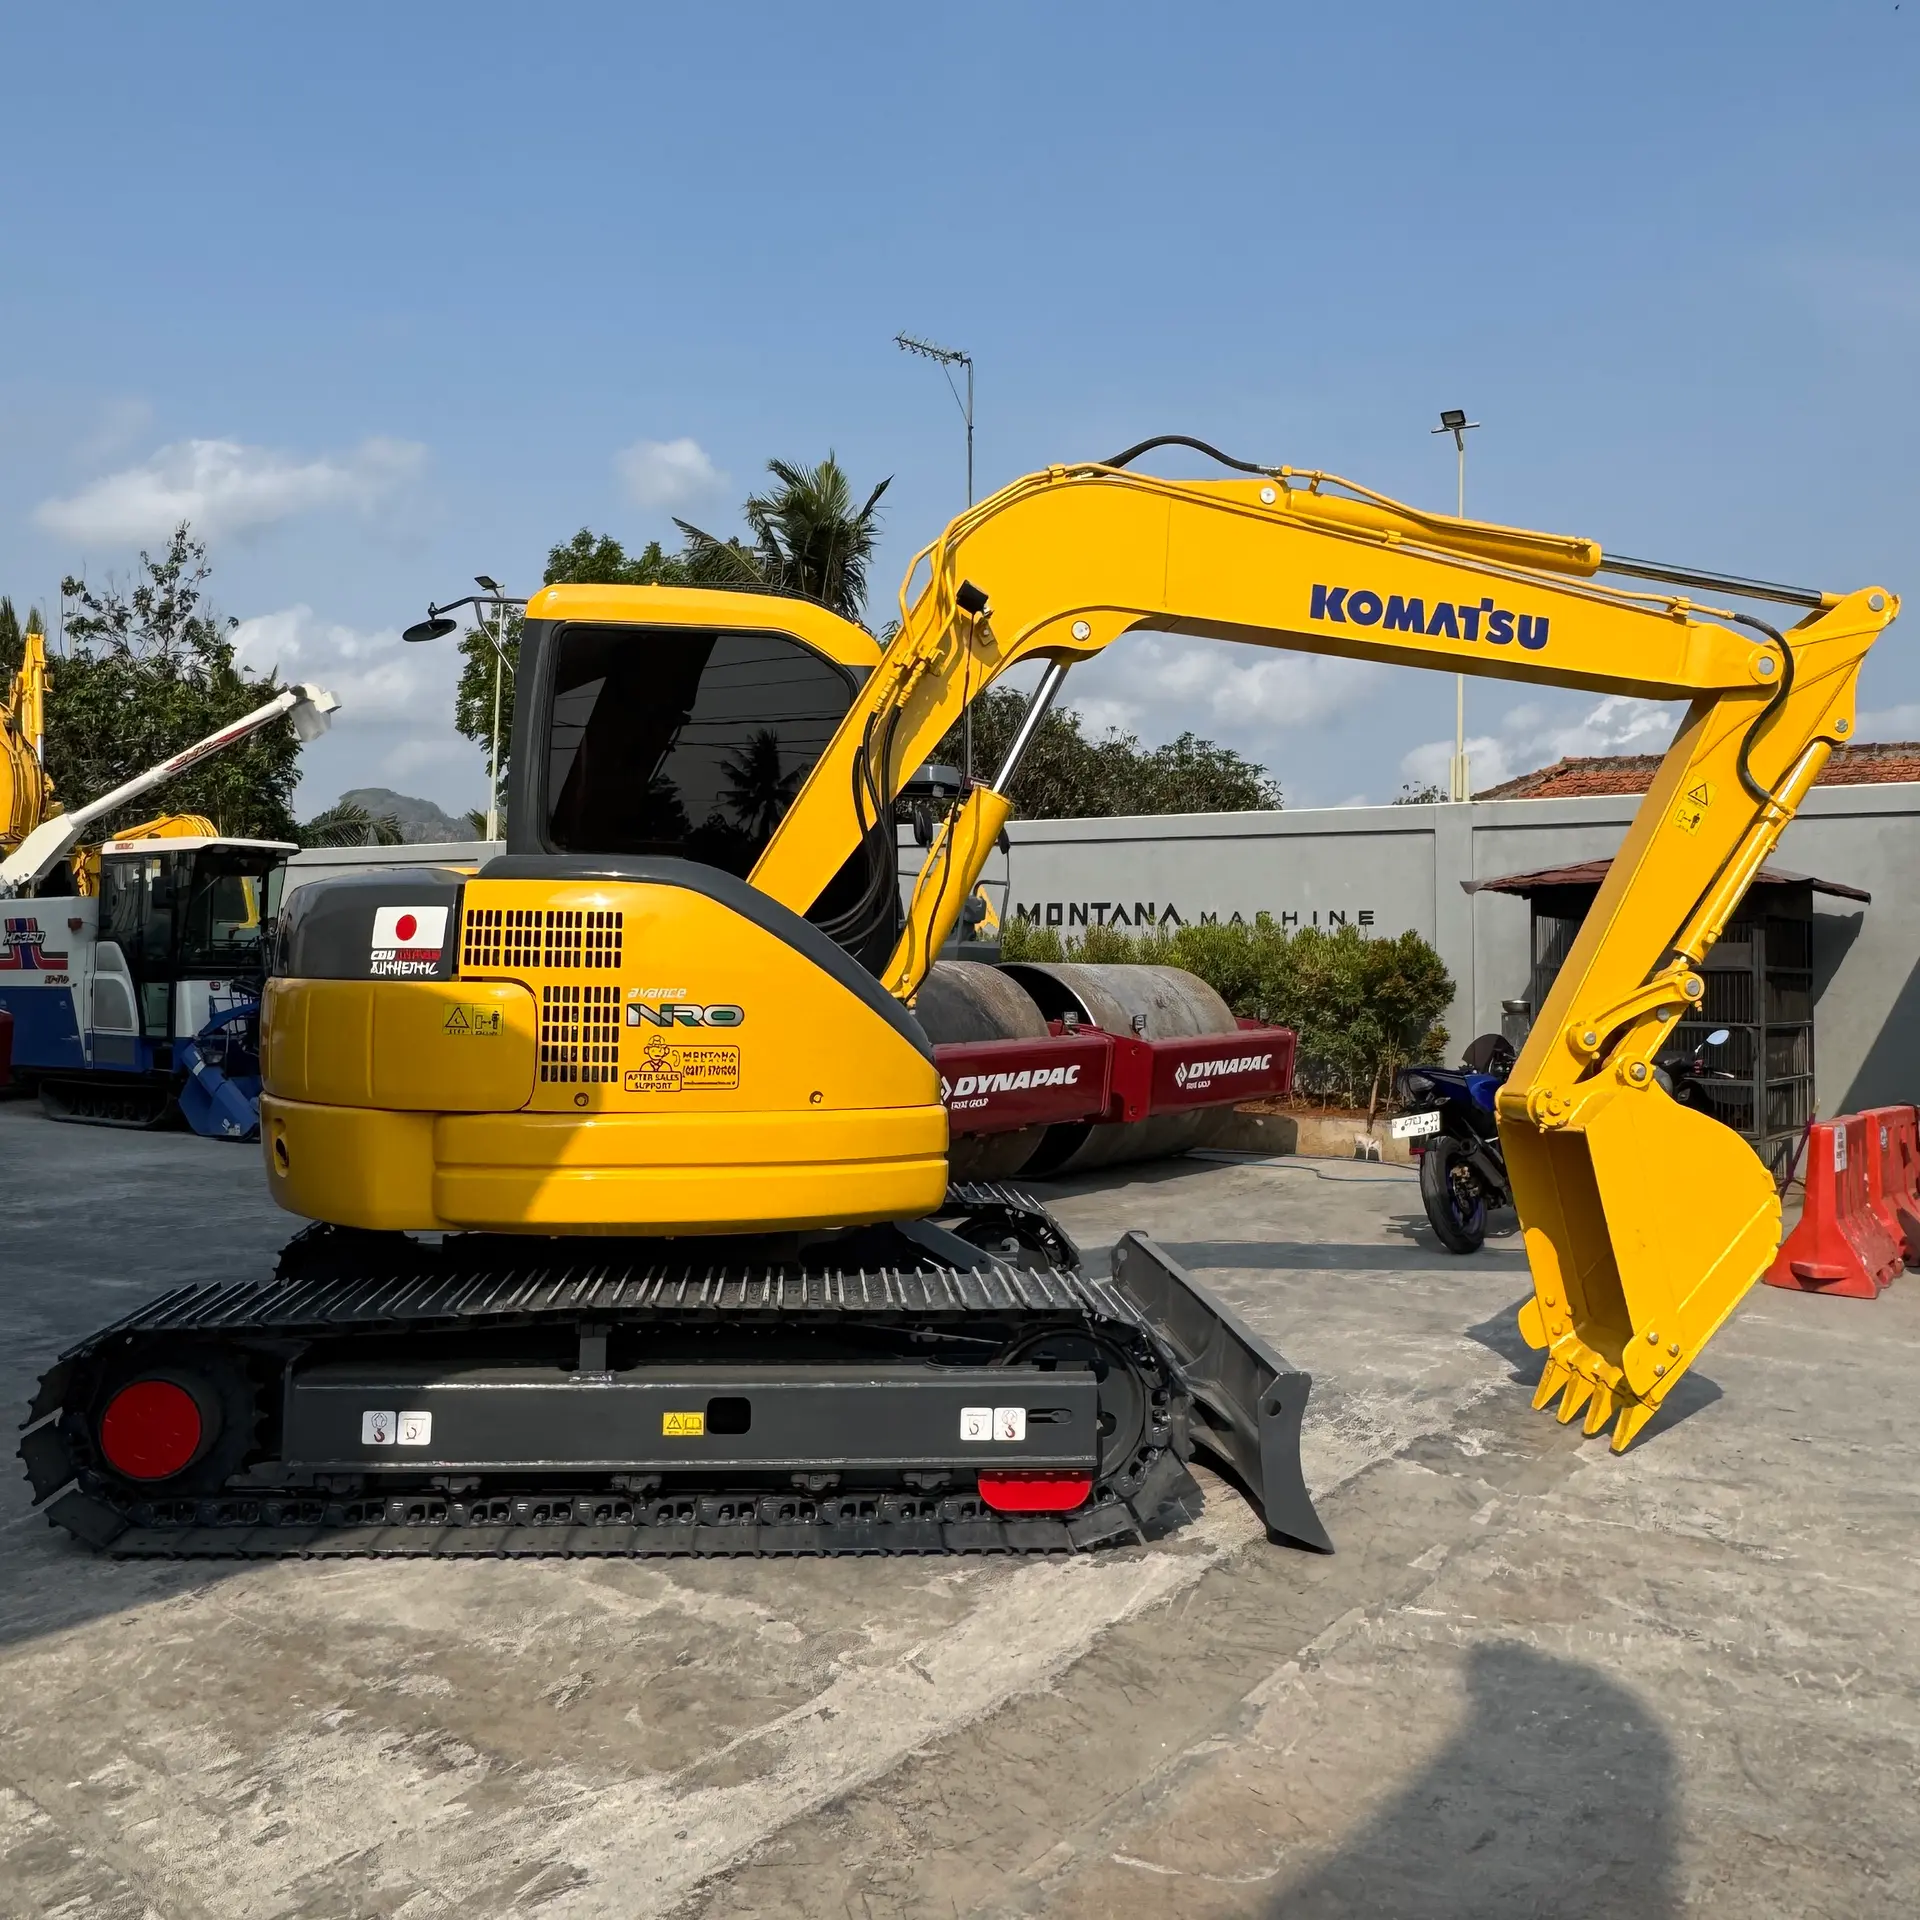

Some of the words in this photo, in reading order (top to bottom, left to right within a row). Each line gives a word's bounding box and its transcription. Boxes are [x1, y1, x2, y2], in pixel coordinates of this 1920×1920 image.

[1310, 584, 1549, 650] KOMATSU
[1017, 902, 1182, 925] MONTANA
[627, 987, 687, 999] avance
[626, 1003, 745, 1027] NRO
[655, 1073, 680, 1081] SALES
[1187, 1053, 1273, 1079] DYNAPAC
[634, 1082, 673, 1090] SUPPORT
[953, 1064, 1081, 1097] DYNAPAC
